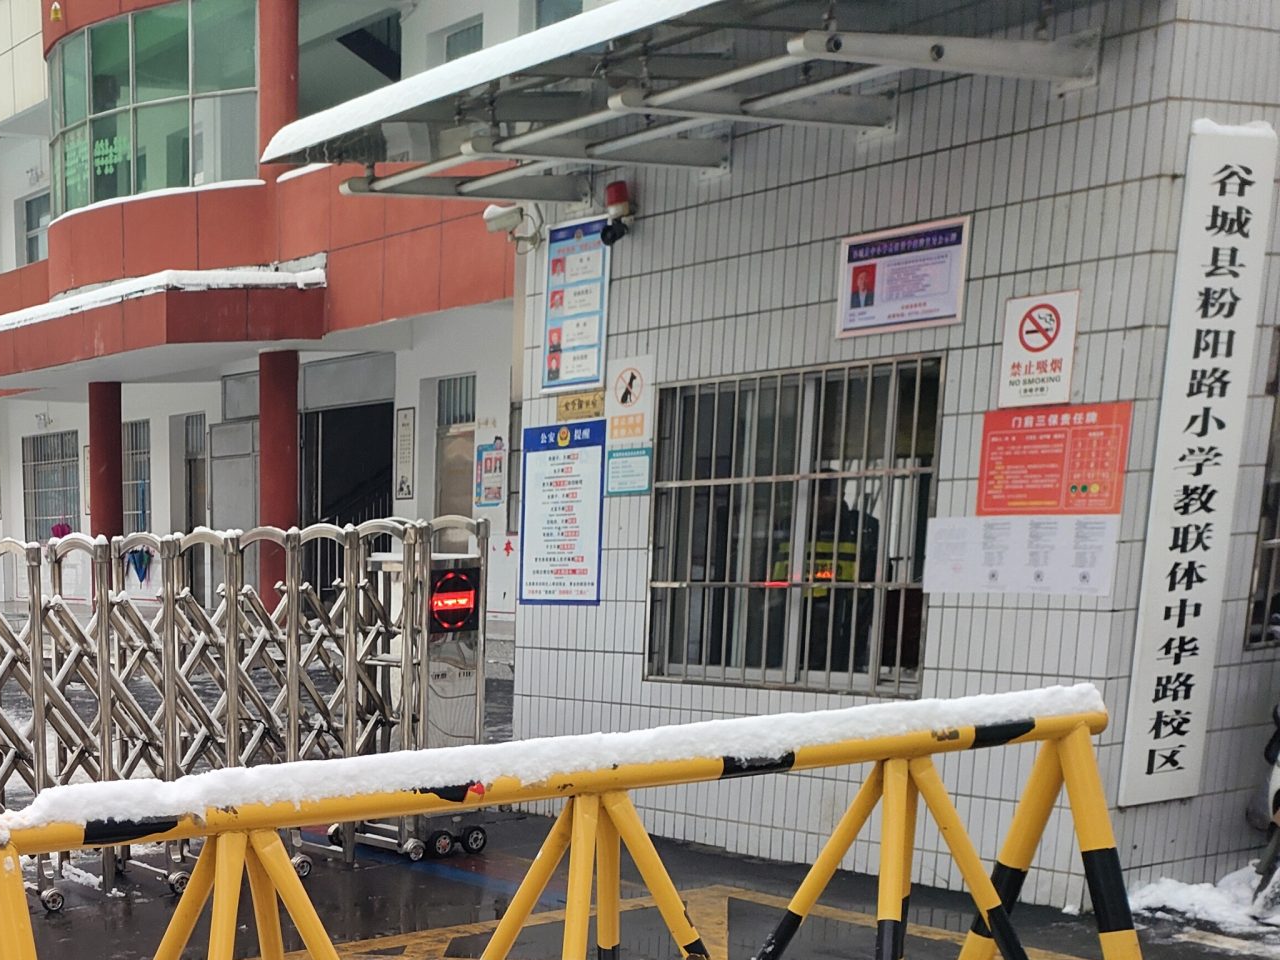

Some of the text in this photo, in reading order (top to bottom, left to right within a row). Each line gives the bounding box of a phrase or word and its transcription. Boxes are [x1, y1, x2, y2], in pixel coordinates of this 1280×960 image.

[1010, 358, 1063, 377] 禁止吸烟
[1009, 375, 1062, 387] NO SMOKING
[540, 428, 592, 444] 公安 提醒
[1146, 163, 1256, 775] 谷城县粉阳路小学教联体中华路校区
